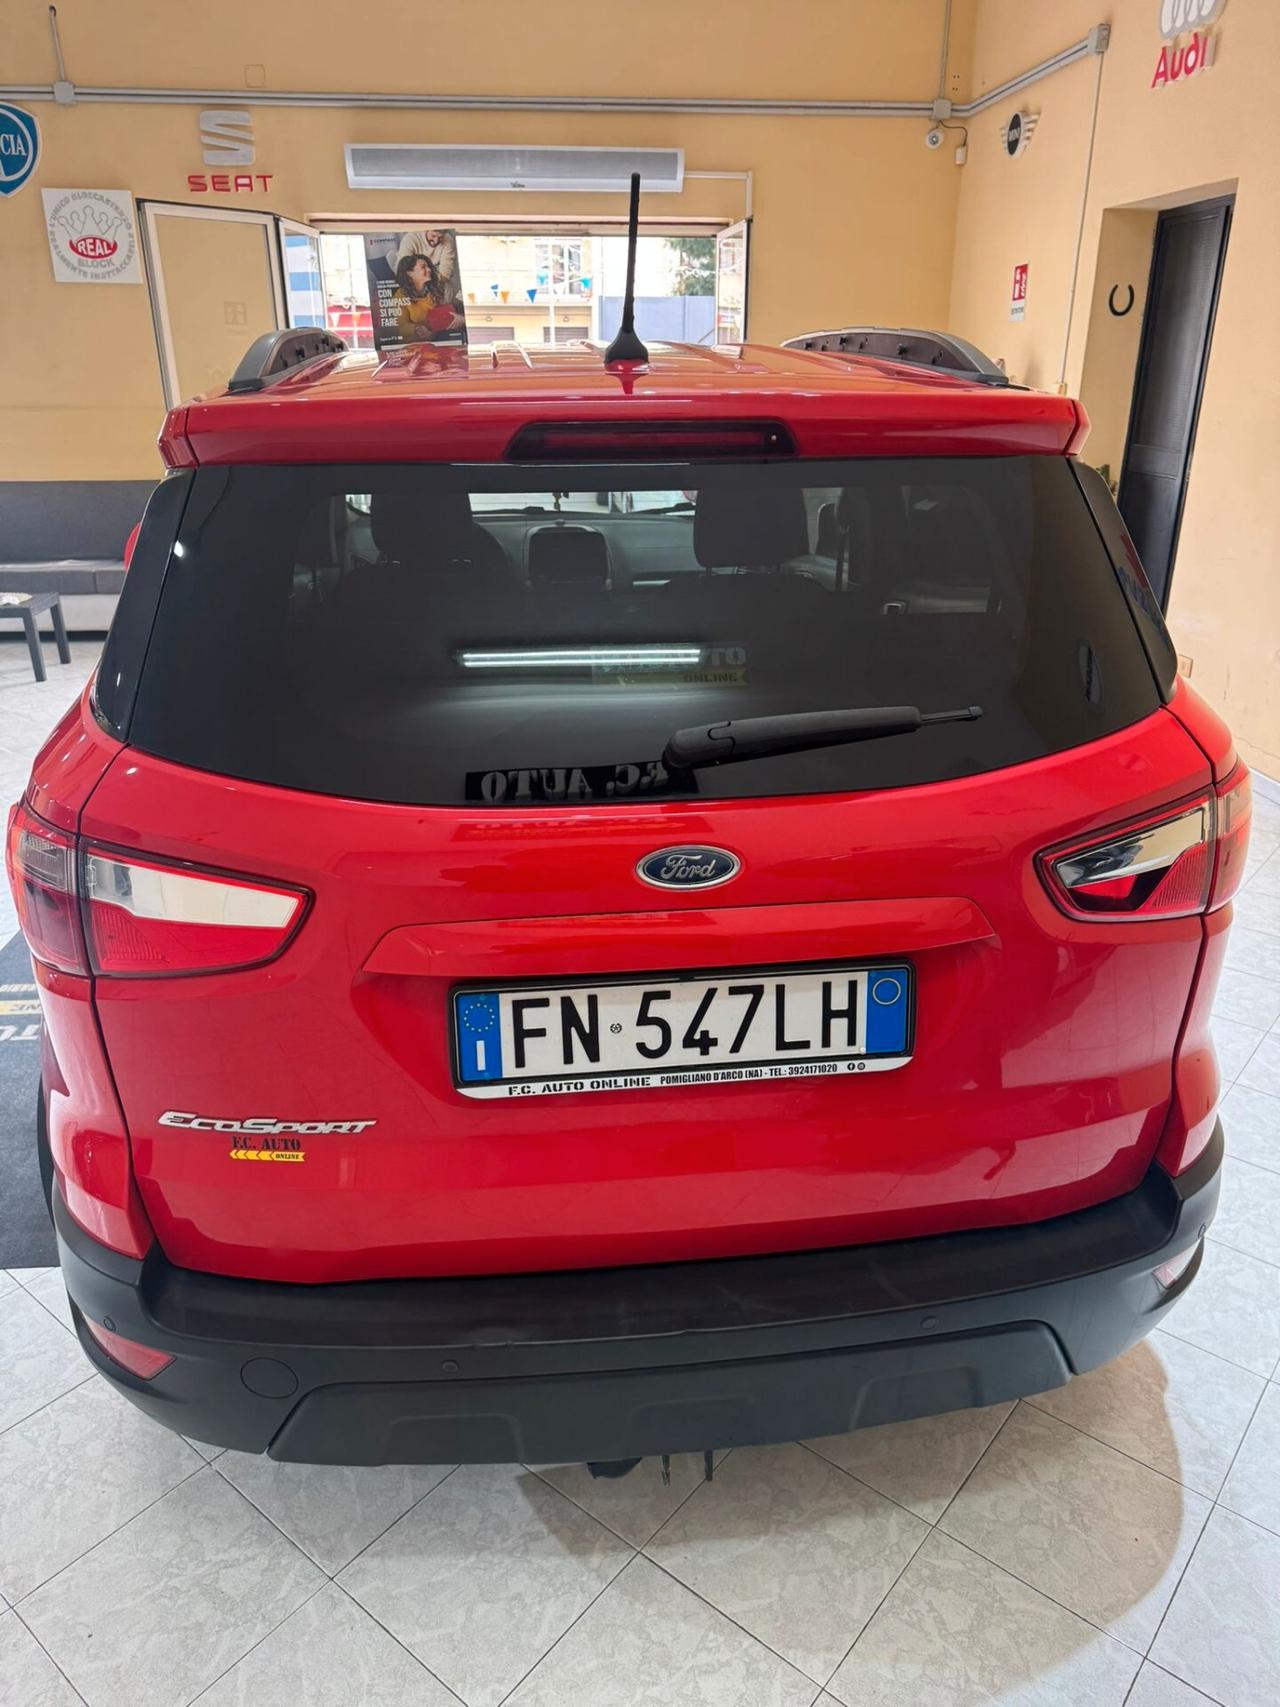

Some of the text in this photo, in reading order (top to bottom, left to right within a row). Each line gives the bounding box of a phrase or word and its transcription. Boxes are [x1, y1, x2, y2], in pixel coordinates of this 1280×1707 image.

[1151, 31, 1209, 88] Audi
[187, 174, 274, 193] SEAT
[77, 238, 113, 256] REAL
[77, 257, 115, 269] BLOCK
[377, 289, 393, 298] CON
[379, 297, 411, 308] COMPASS
[381, 318, 399, 327] FARE
[660, 854, 717, 879] Ford
[508, 1085, 536, 1096] F.C.
[541, 1081, 584, 1093] AUTO
[590, 1076, 651, 1090] ONLINE
[660, 1073, 711, 1084] POMIGLIANO
[713, 1070, 743, 1082] D'ARCO
[788, 1063, 838, 1076] 3924171020
[232, 1136, 301, 1150] F.C. AUTO
